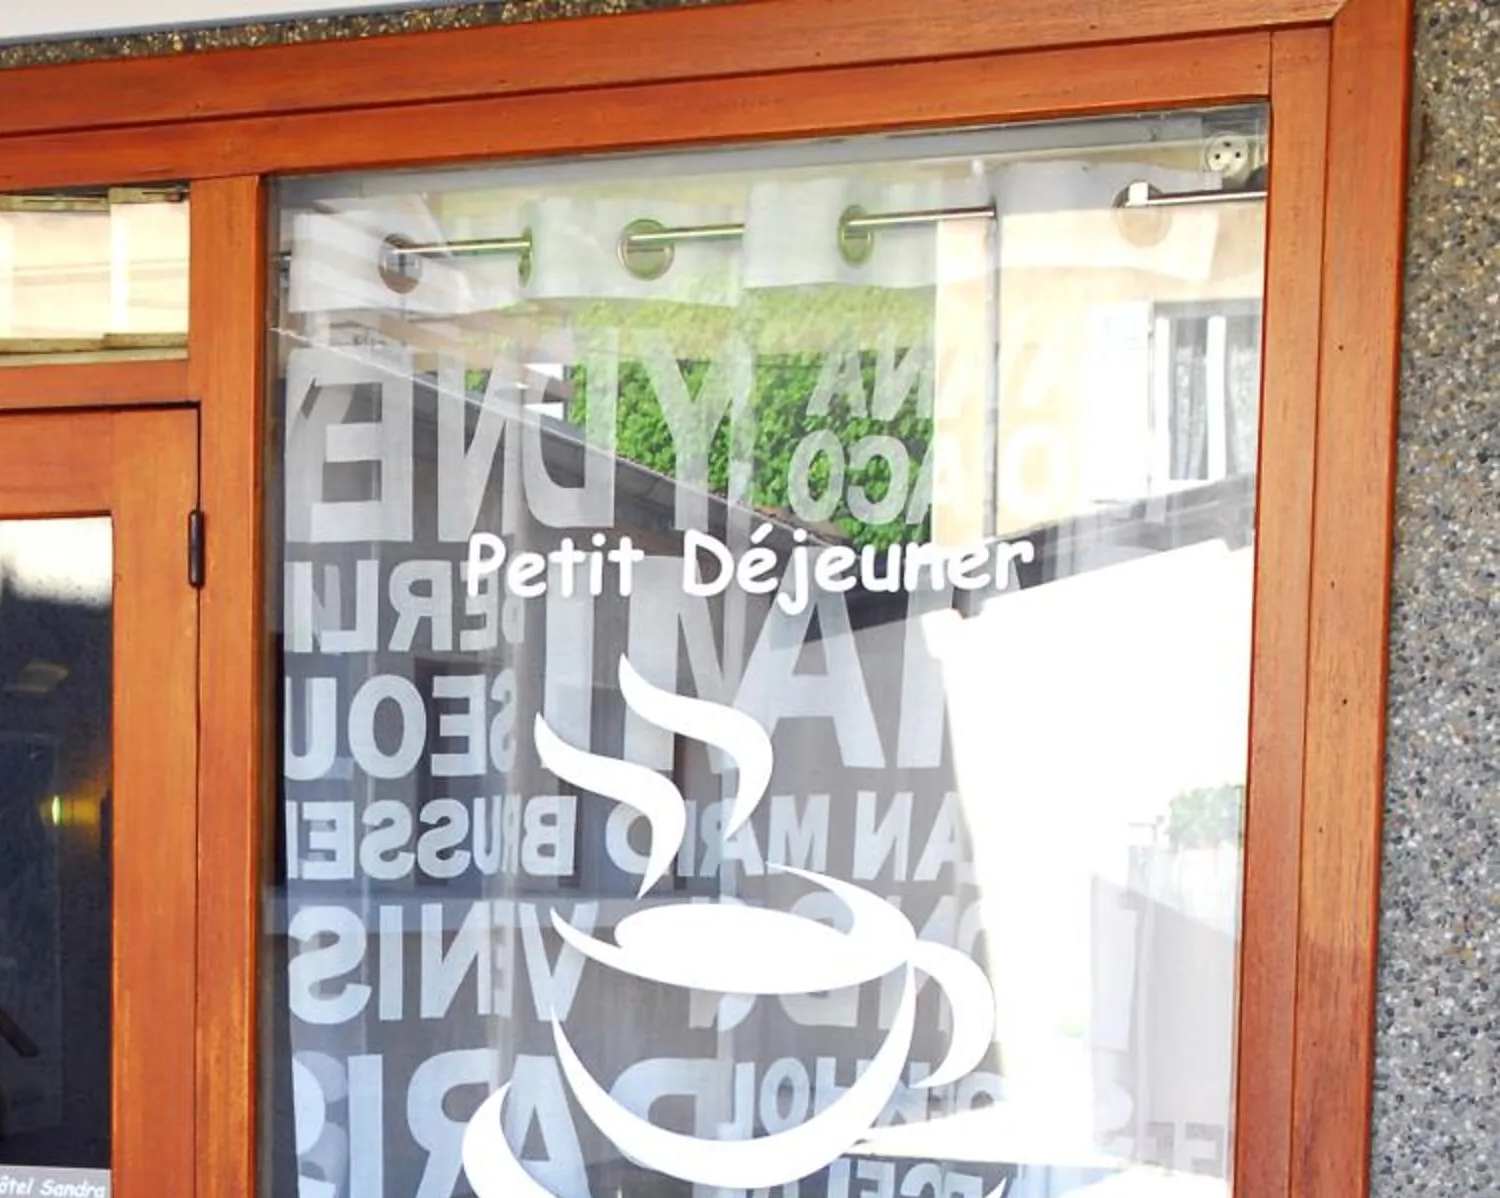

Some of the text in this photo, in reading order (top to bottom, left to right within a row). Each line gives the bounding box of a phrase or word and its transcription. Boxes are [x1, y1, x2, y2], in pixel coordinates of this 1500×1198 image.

[466, 522, 1035, 616] Petit Déjeuner
[40, 1178, 106, 1198] Sandra
